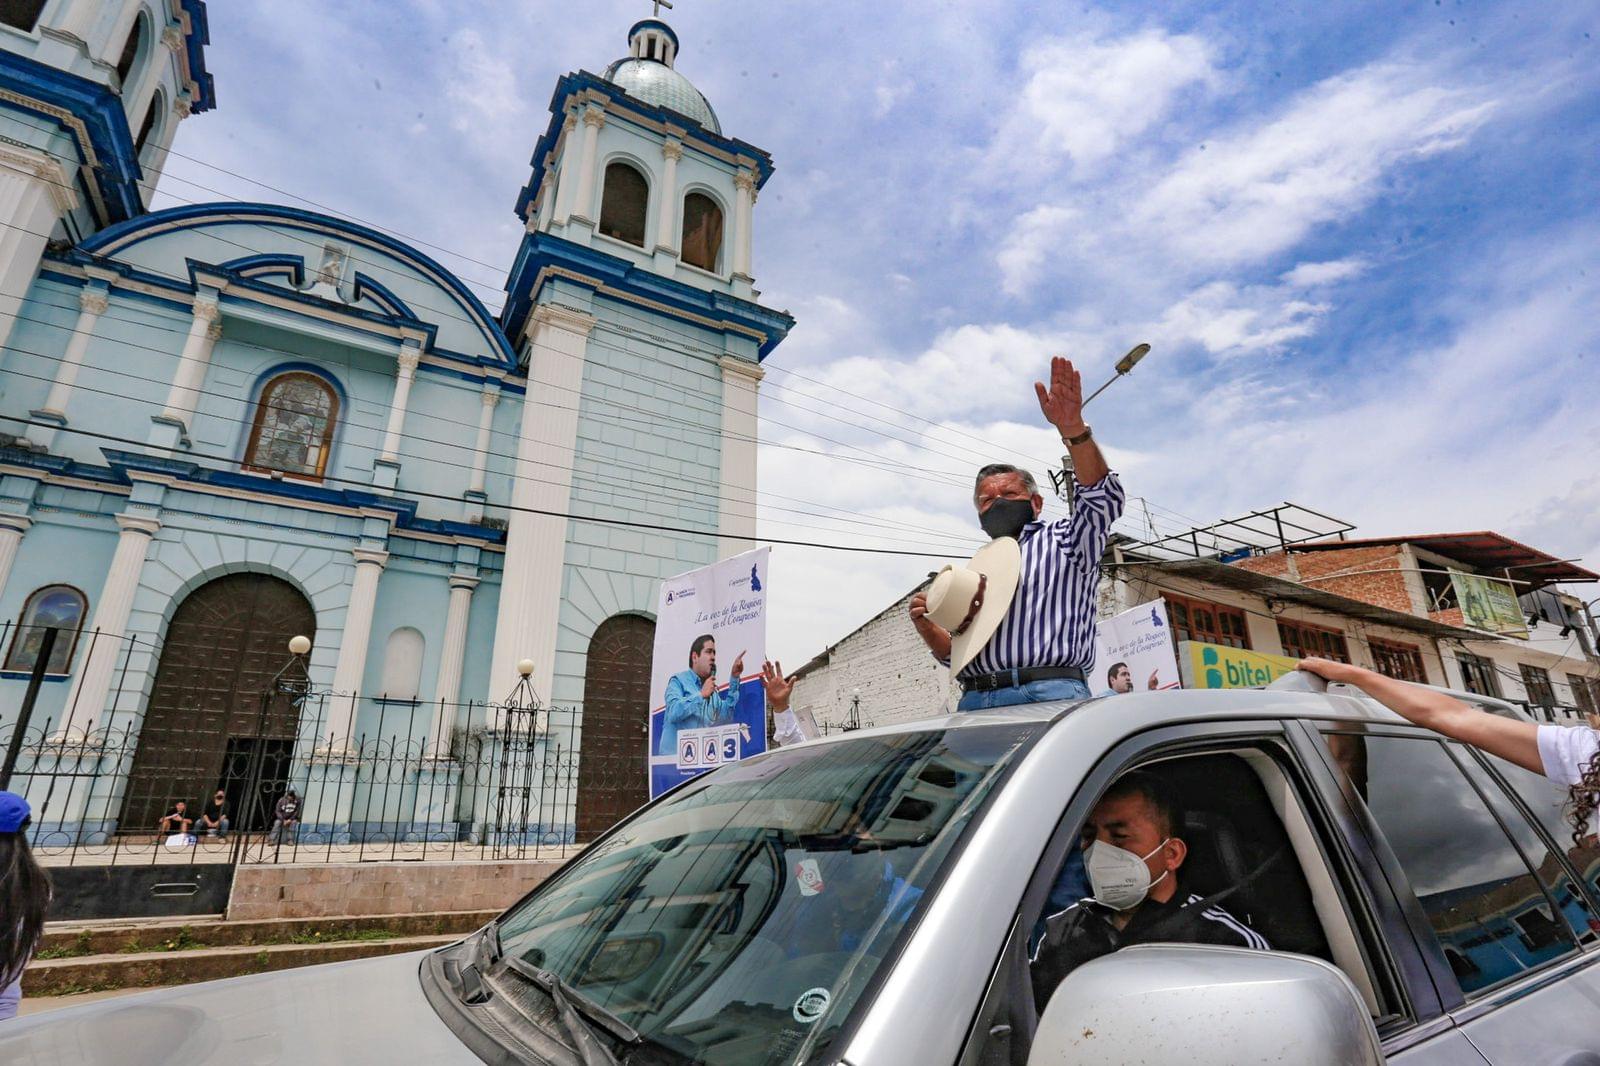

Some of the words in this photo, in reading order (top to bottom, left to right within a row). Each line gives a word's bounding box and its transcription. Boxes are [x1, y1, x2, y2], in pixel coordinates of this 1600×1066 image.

[722, 607, 729, 616] de
[730, 602, 737, 614] la
[712, 622, 720, 630] en
[720, 618, 727, 627] el
[1225, 659, 1272, 686] bitel
[723, 738, 736, 758] 3
